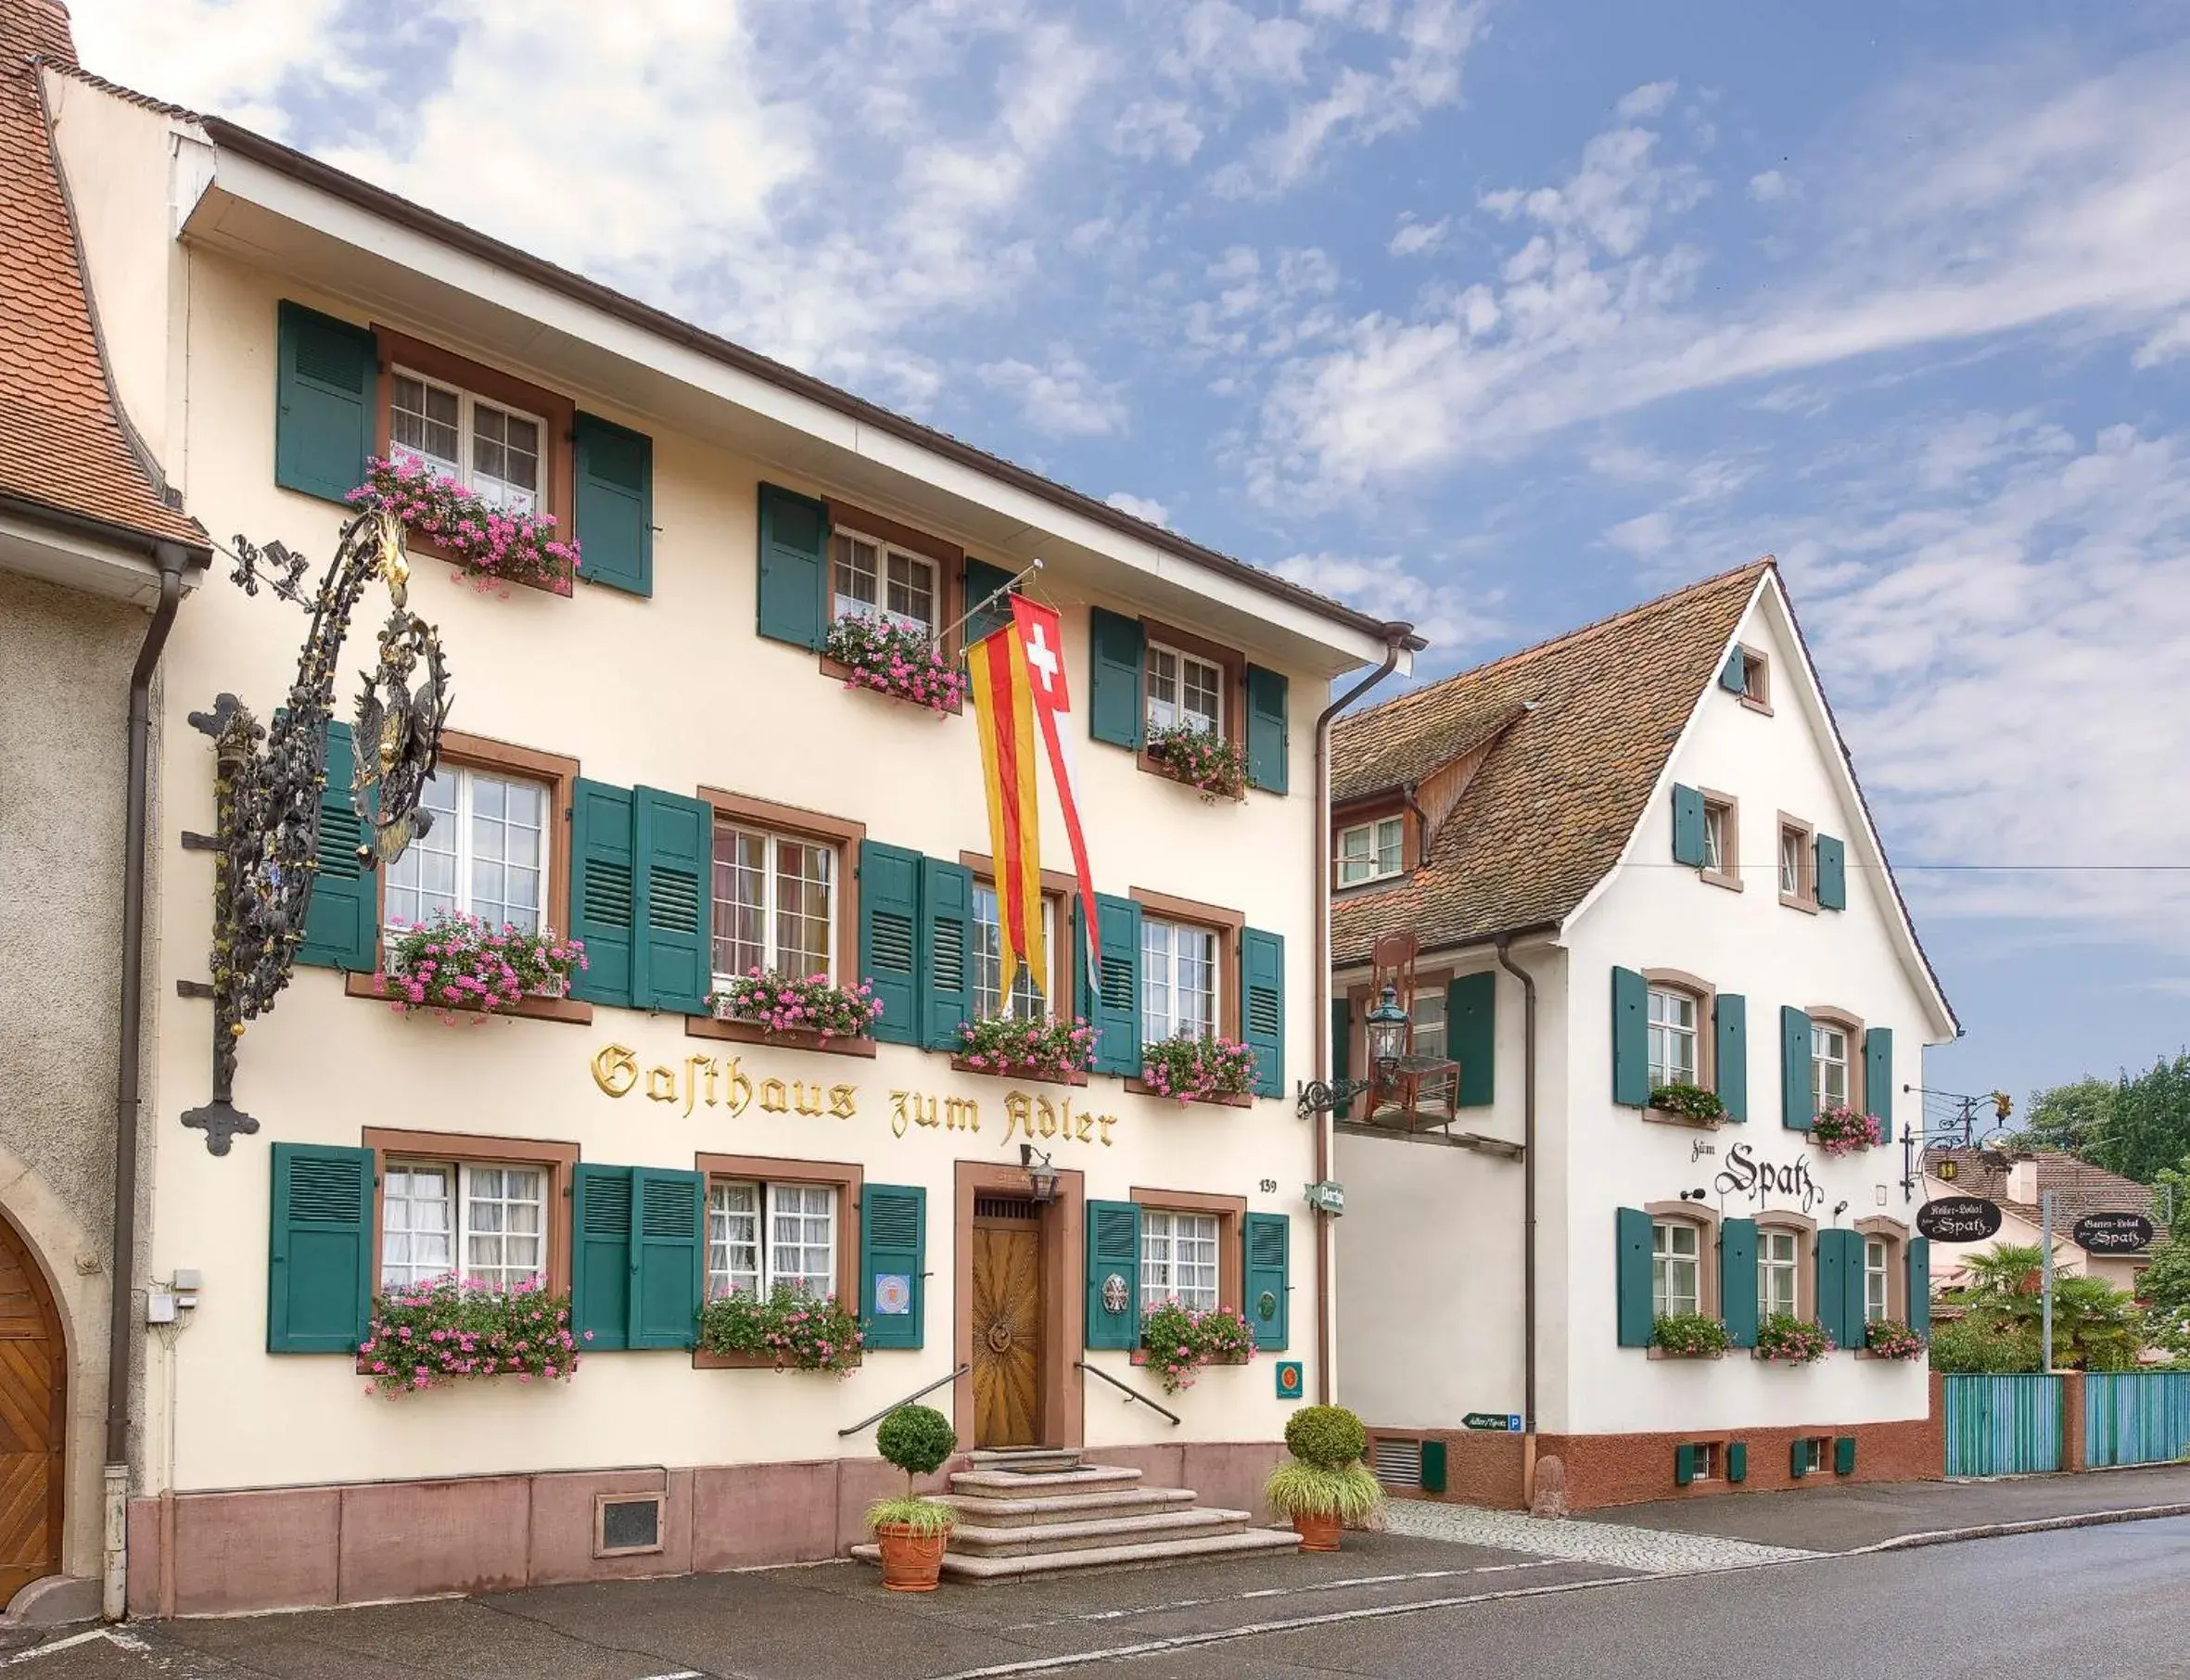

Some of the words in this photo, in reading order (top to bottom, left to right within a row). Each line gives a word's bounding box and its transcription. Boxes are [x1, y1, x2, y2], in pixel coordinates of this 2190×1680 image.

[887, 1088, 981, 1139] zum
[1000, 1088, 1119, 1147] Adler
[1259, 1178, 1277, 1193] 139
[1715, 1142, 1825, 1214] Spatz
[1512, 1418, 1520, 1428] P
